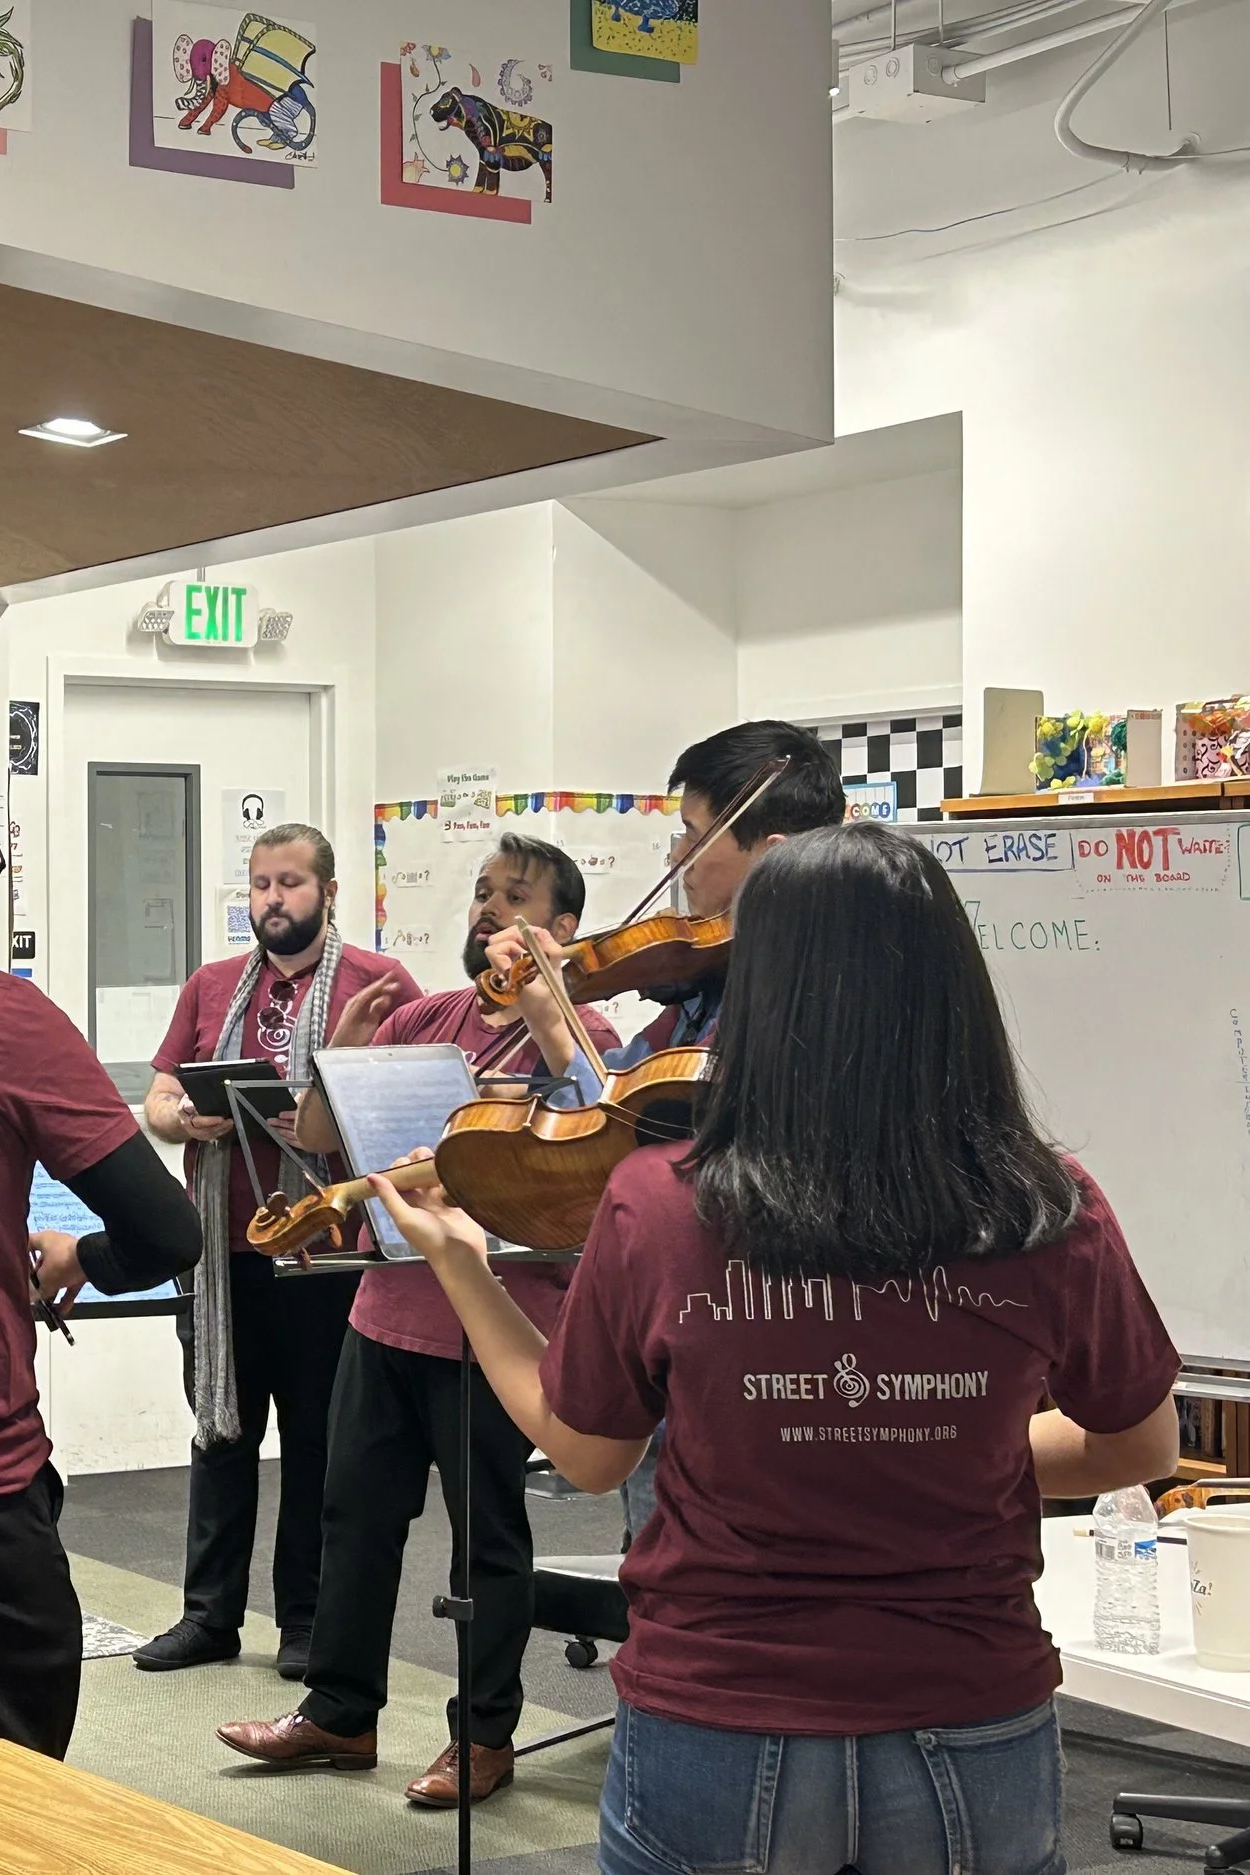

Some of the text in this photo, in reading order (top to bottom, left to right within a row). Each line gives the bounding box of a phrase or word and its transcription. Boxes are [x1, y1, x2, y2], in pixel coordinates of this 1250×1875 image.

[186, 585, 247, 642] EXIT
[931, 833, 1058, 864] OT ERASE
[1077, 828, 1224, 870] DO NOT WRITE
[1096, 872, 1190, 883] ON THE BOARD
[743, 1371, 989, 1400] STREET SYMPHONY
[780, 1425, 957, 1443] WWW.STREETSYMPHONY.ORG
